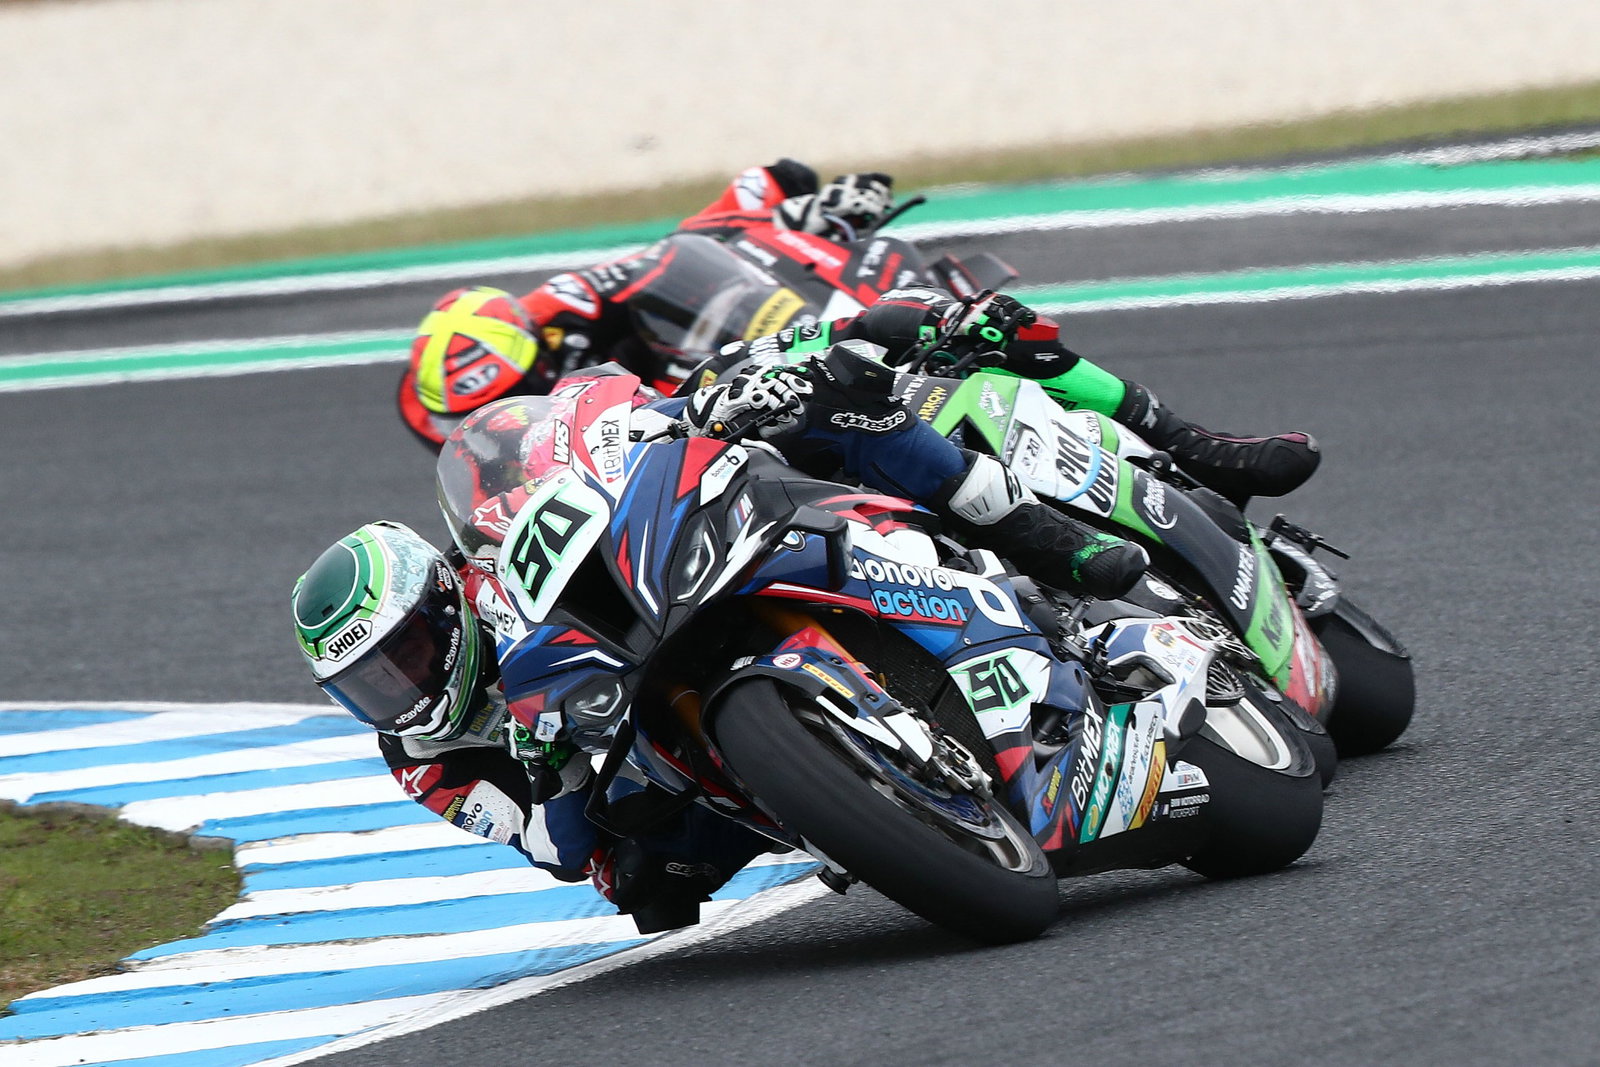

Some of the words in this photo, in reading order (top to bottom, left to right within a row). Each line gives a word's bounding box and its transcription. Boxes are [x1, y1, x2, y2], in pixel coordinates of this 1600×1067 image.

[602, 418, 620, 474] BitMEX
[508, 492, 597, 607] 50
[871, 589, 968, 622] action
[328, 623, 368, 659] SHOEI
[959, 655, 1032, 714] 50
[1071, 696, 1104, 812] BitMEX
[1094, 711, 1121, 813] MOOREX
[461, 803, 483, 833] novo
